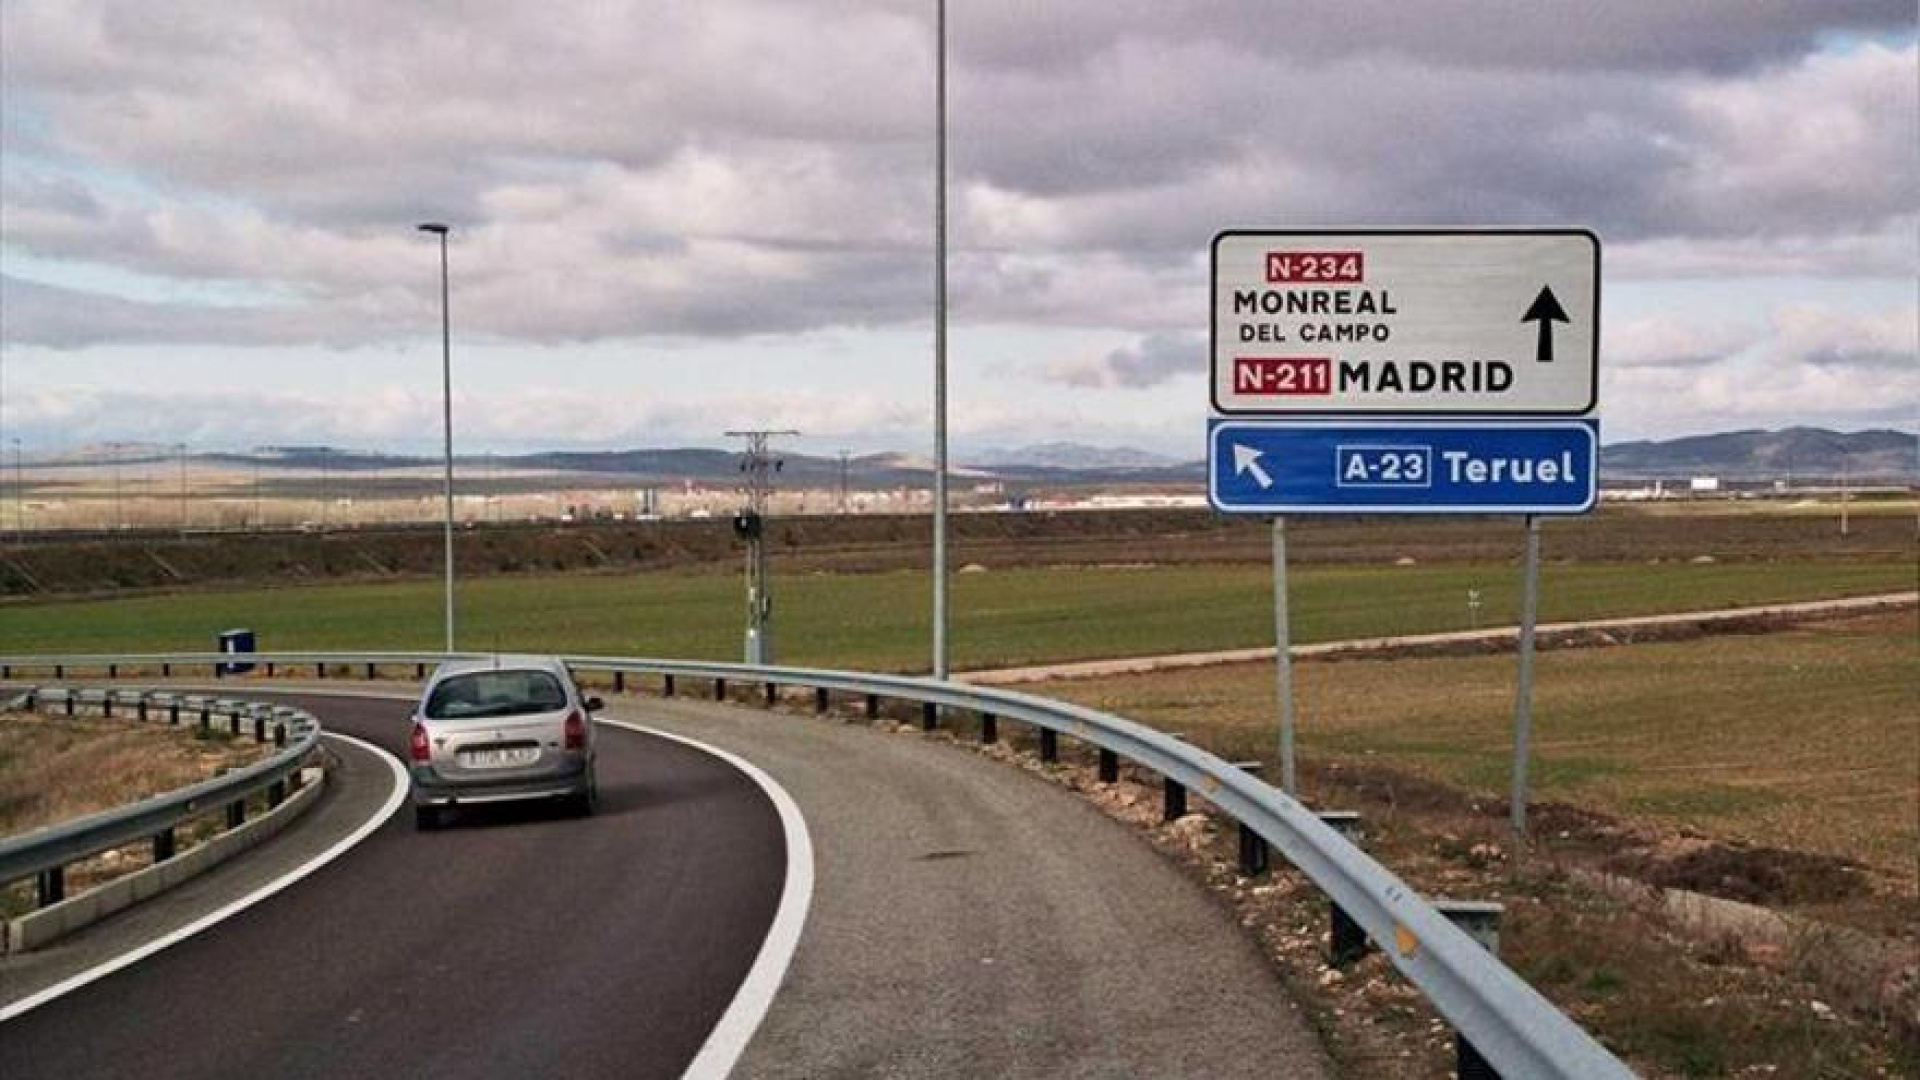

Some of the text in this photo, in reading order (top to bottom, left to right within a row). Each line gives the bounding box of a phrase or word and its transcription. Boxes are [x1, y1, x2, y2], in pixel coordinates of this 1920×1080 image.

[1270, 256, 1358, 278] N-234
[1234, 290, 1397, 314] MONREAL
[1240, 323, 1389, 342] DEL CAMPO
[1238, 360, 1513, 392] N-211 MADRID
[1344, 451, 1575, 483] A-23 Teruel
